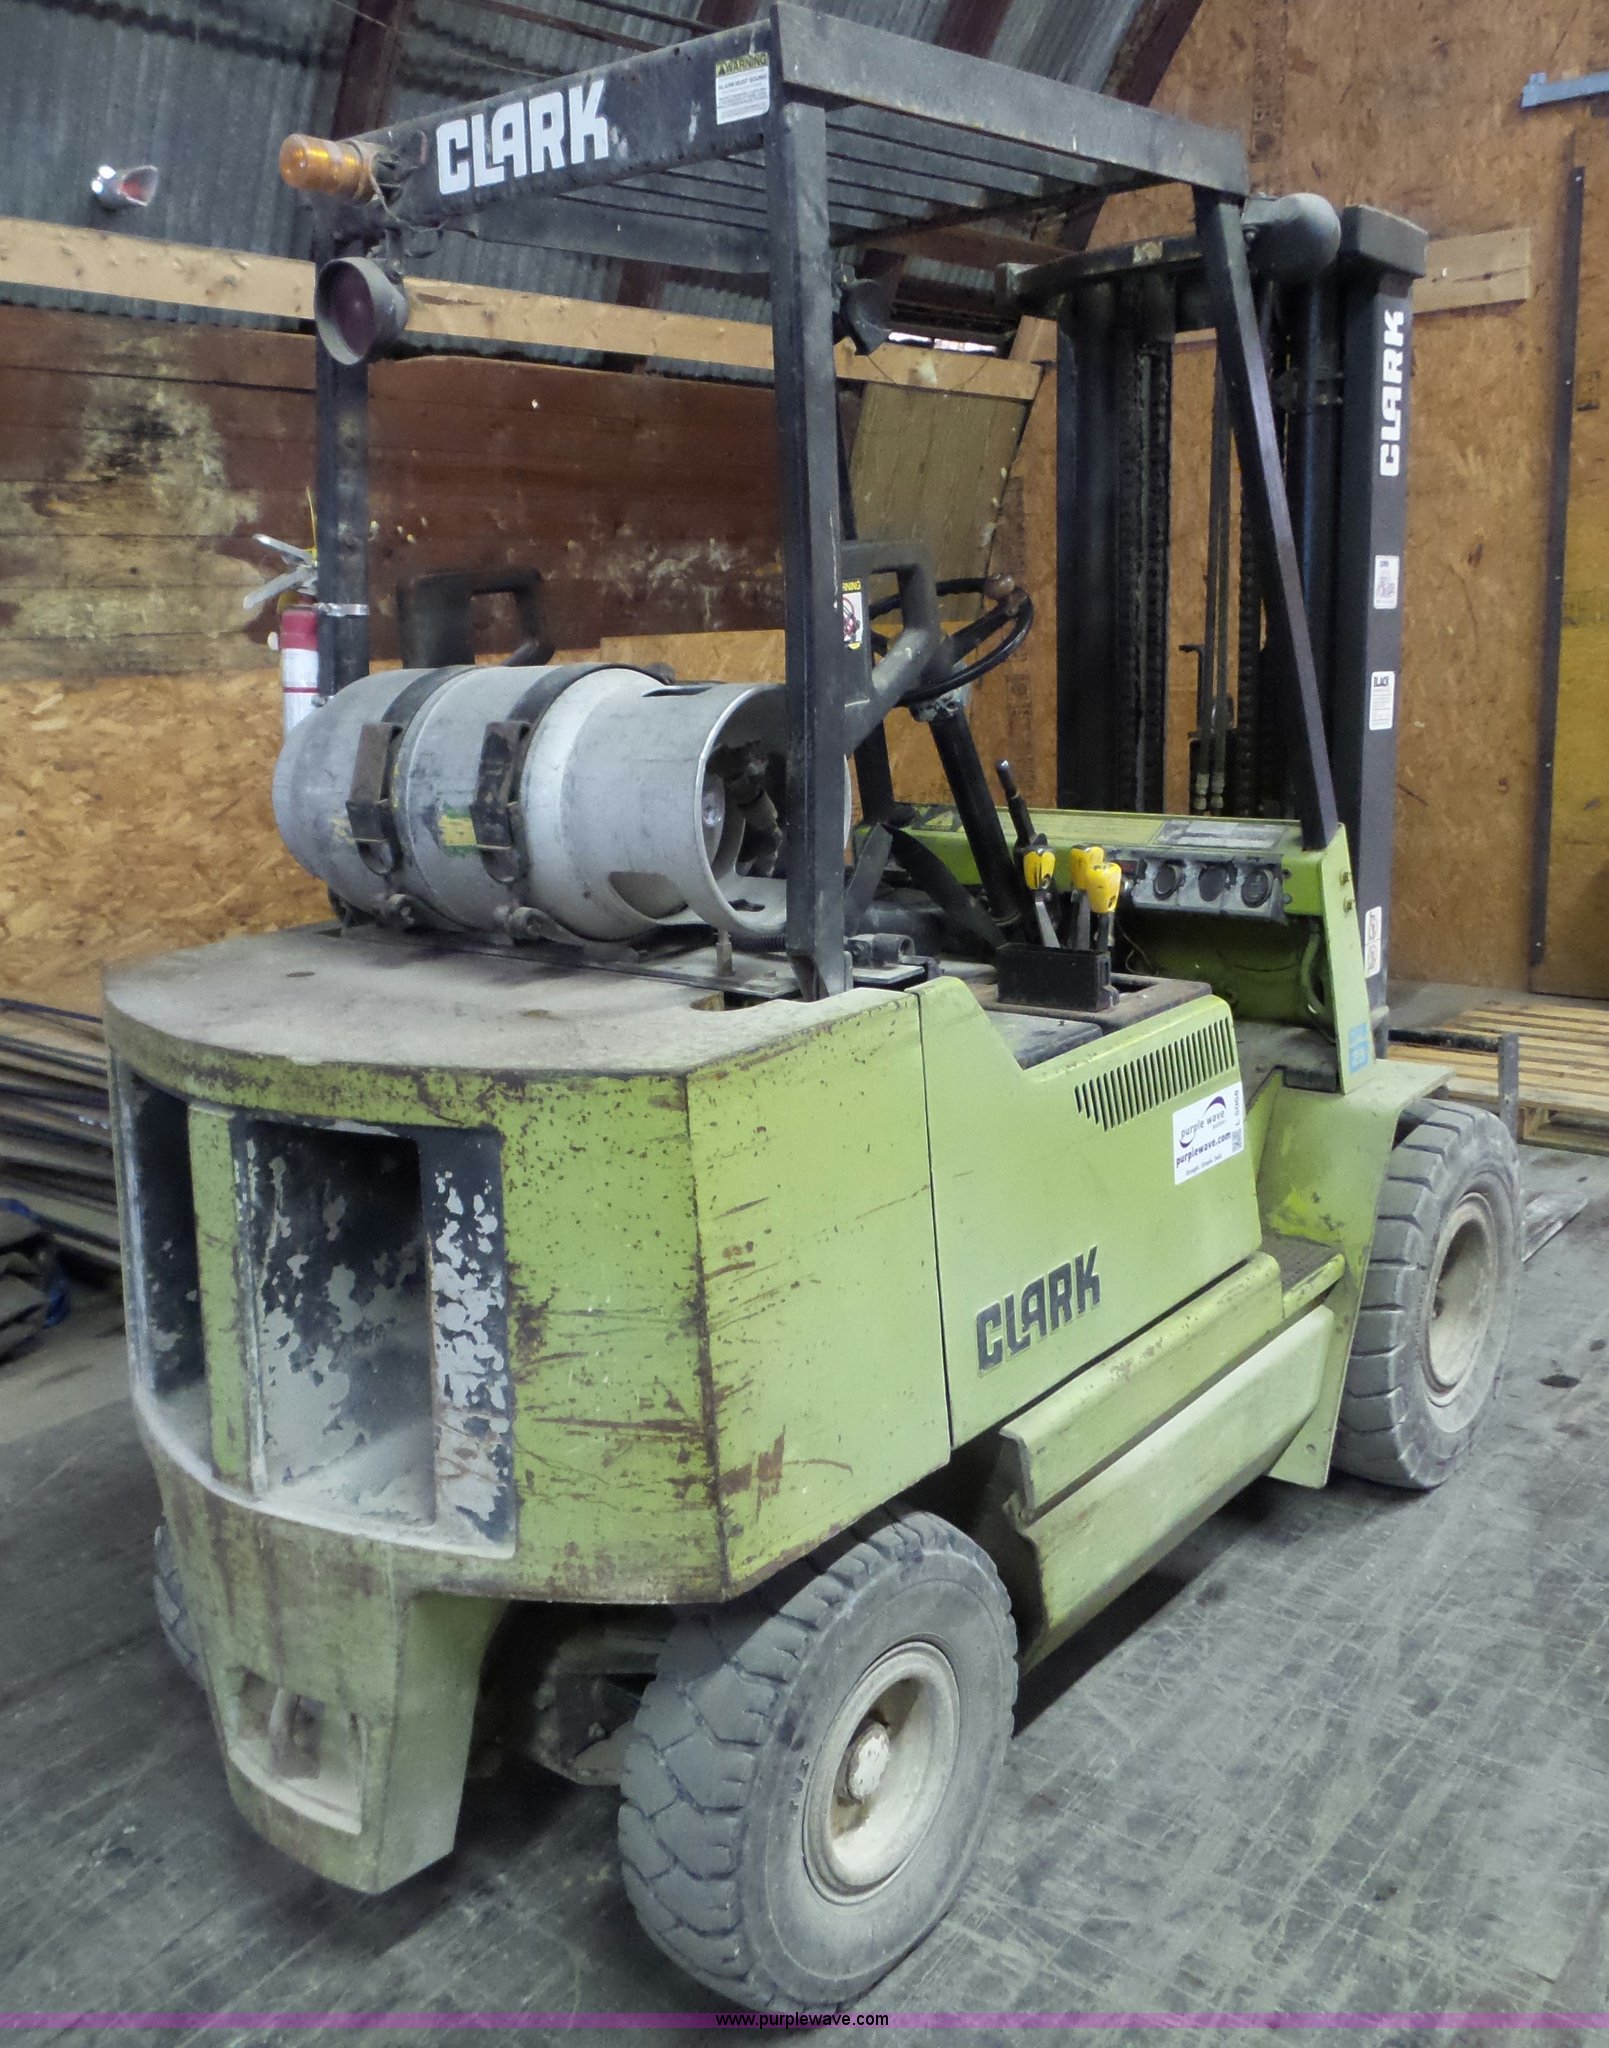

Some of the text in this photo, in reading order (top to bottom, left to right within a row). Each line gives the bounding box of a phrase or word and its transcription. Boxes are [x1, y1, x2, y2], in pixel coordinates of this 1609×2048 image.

[725, 53, 767, 74] WARNING
[436, 79, 609, 195] CLARK
[1379, 309, 1405, 477] CLARK
[1176, 1131, 1231, 1168] purplewave.com
[1181, 1119, 1204, 1140] purple
[1206, 1110, 1225, 1125] wave
[976, 1245, 1101, 1371] CLARK
